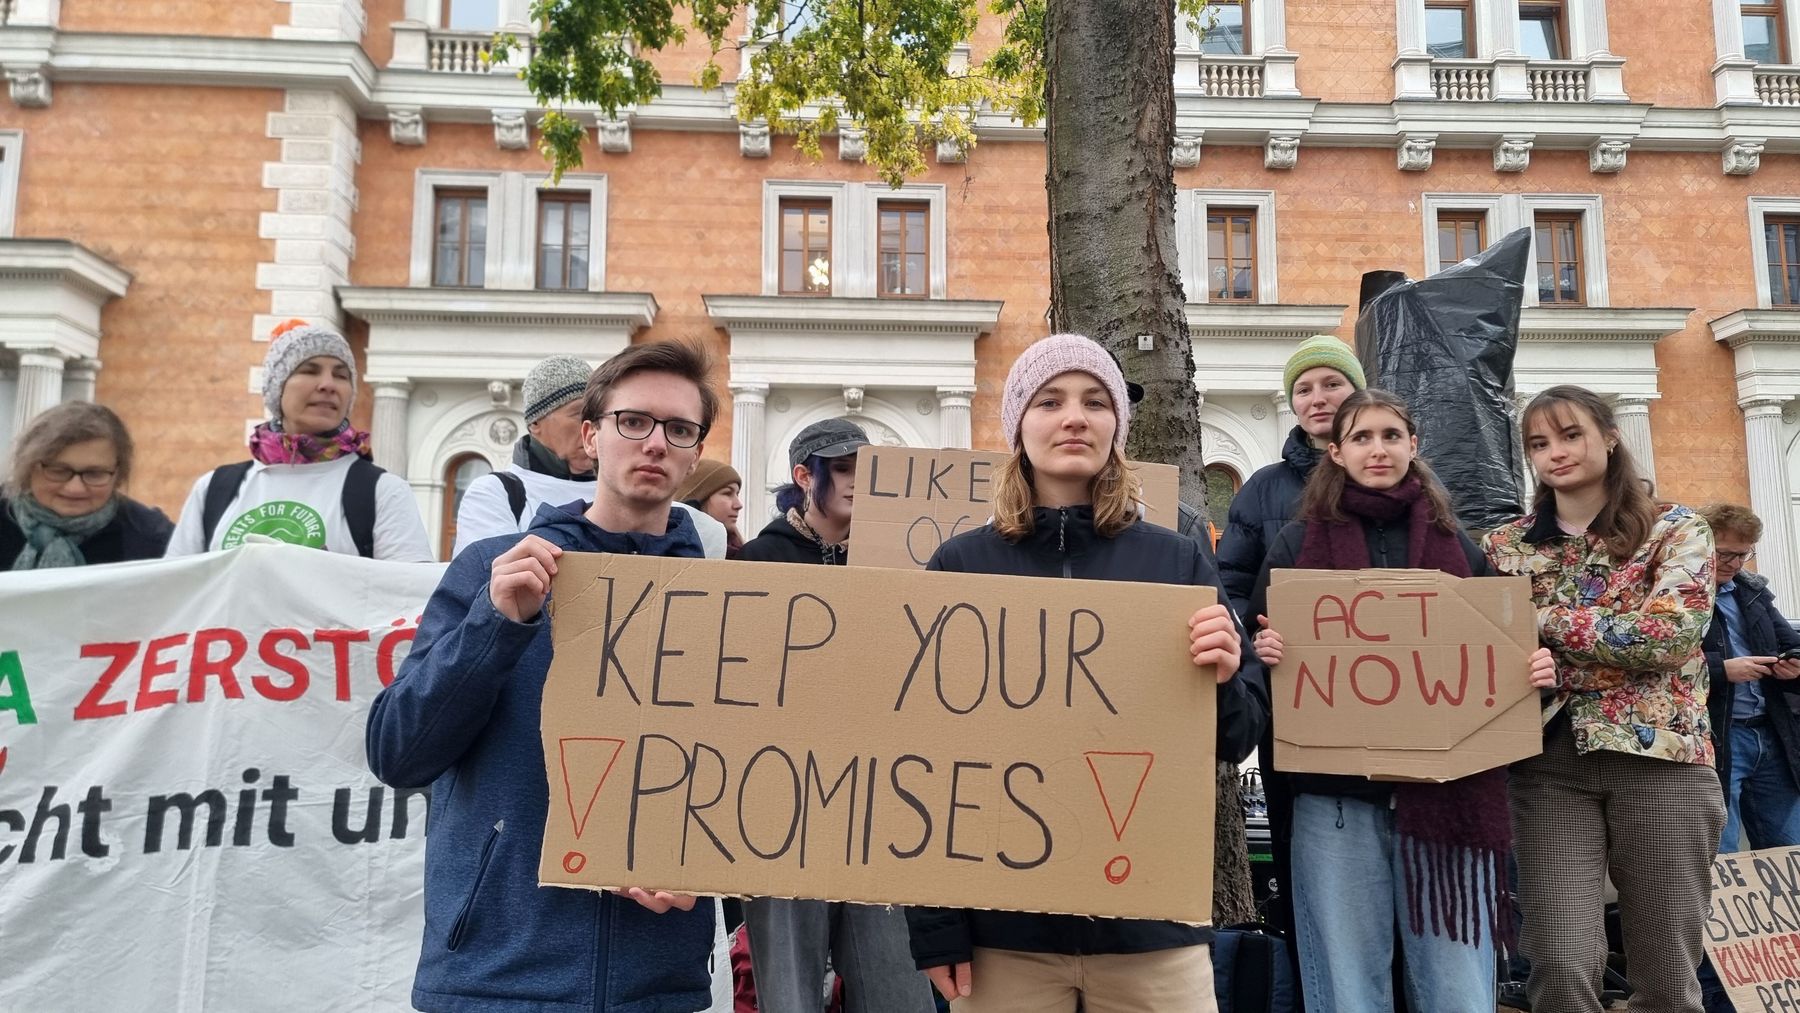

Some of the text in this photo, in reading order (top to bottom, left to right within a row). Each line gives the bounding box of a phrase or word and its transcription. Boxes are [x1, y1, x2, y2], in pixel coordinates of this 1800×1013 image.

[869, 455, 992, 502] LIKE
[260, 504, 285, 517] FOR
[290, 506, 321, 539] FUTURE
[1313, 590, 1438, 642] ACT
[597, 577, 1118, 715] KEEP YOUR
[1293, 643, 1496, 709] NOW!
[143, 767, 299, 854] mit
[627, 734, 1052, 872] PROMISES
[1712, 859, 1747, 889] BE
[1704, 889, 1800, 942] BLOCKI
